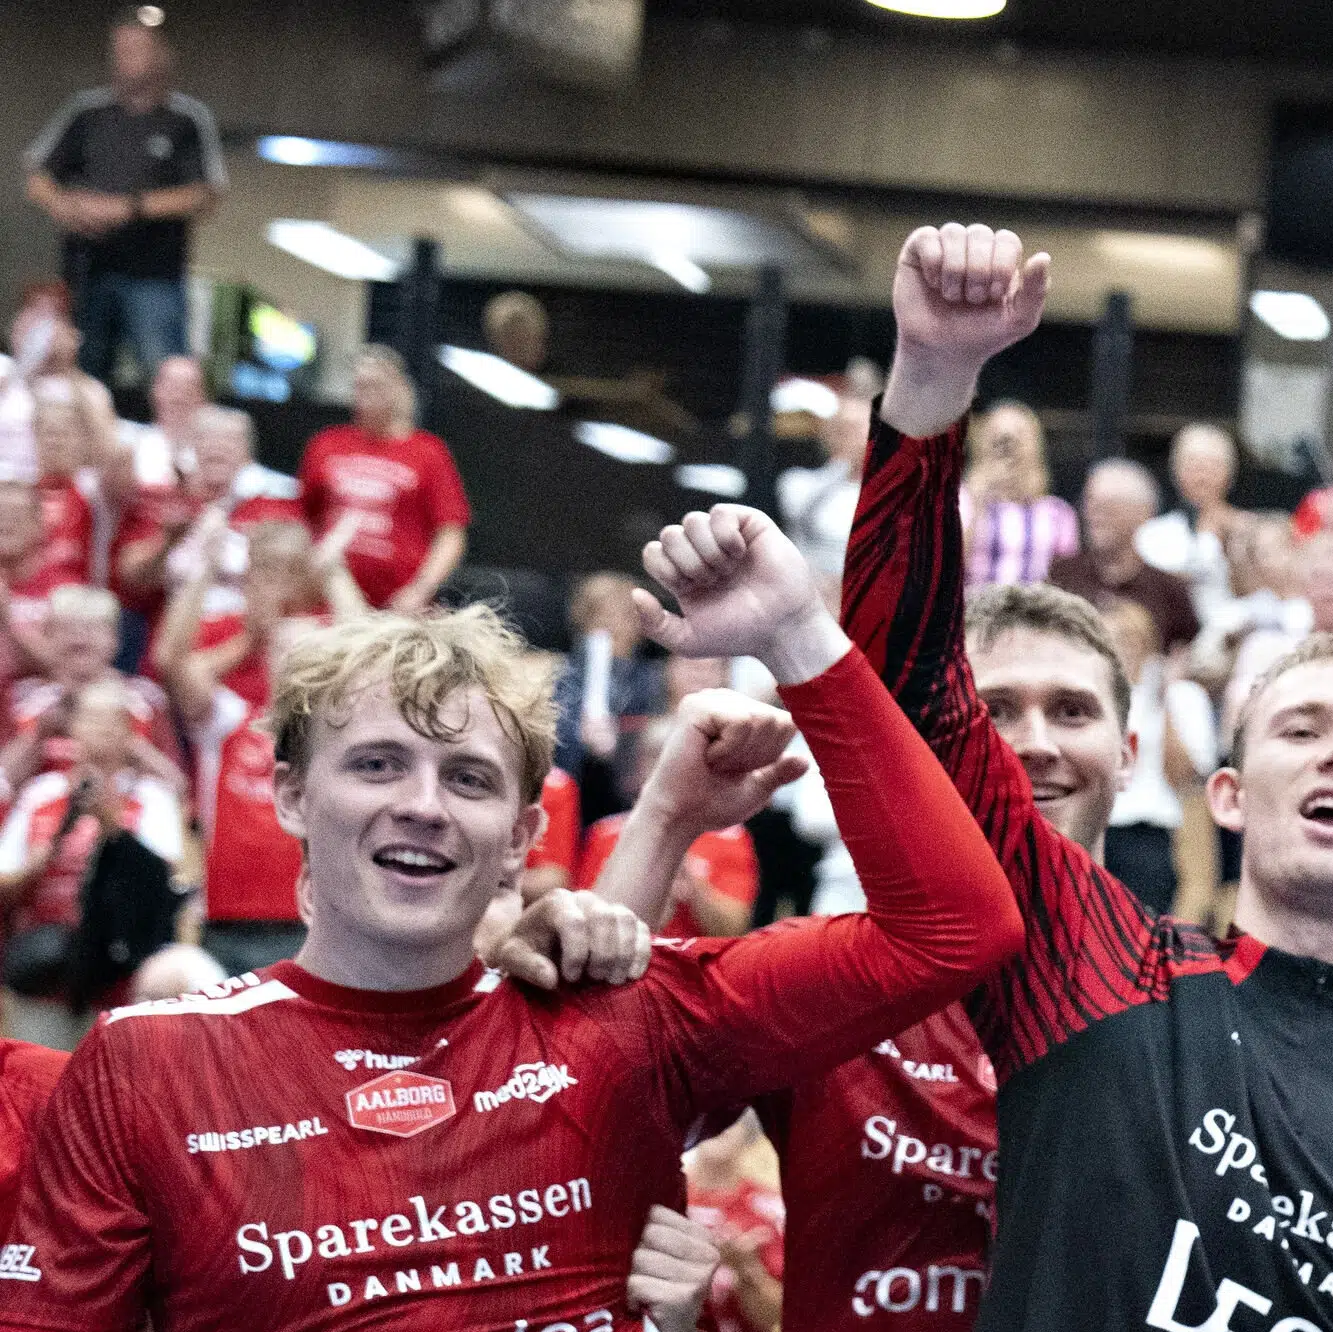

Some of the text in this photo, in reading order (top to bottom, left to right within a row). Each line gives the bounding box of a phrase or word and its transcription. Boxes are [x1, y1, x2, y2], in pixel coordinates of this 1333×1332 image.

[355, 1085, 447, 1112] AALBORG
[187, 1116, 329, 1154] SWISSPEARL
[235, 1177, 593, 1280] Sparekassen
[327, 1245, 552, 1307] DANMARK
